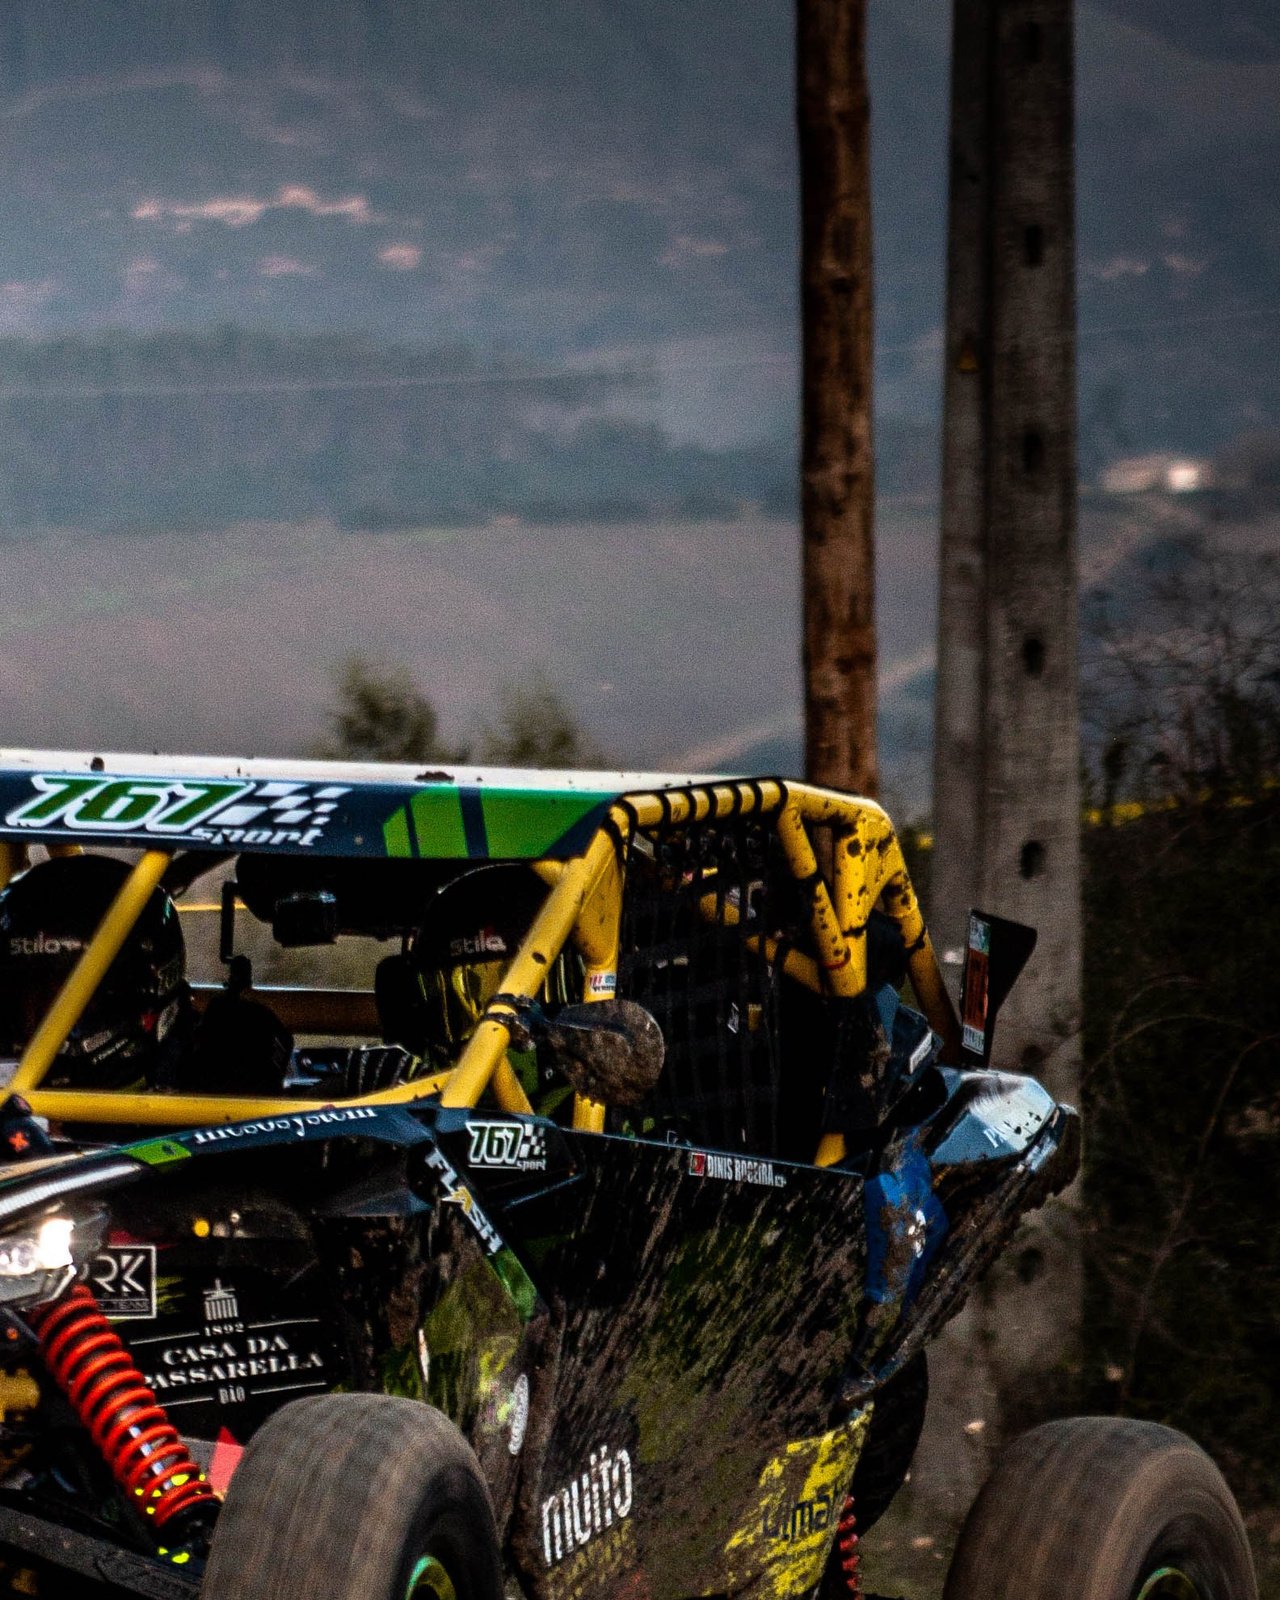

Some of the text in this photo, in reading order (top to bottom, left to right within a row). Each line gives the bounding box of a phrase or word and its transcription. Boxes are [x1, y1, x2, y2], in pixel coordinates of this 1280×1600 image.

[5, 774, 255, 833] 767
[190, 827, 326, 848] sport
[465, 1121, 523, 1164] 767
[517, 1160, 547, 1173] sport
[706, 1153, 733, 1181] DINIS
[423, 1145, 504, 1256] FLASH
[203, 1321, 245, 1338] 1892
[162, 1333, 289, 1367] CASA DA
[540, 1444, 632, 1567] muito
